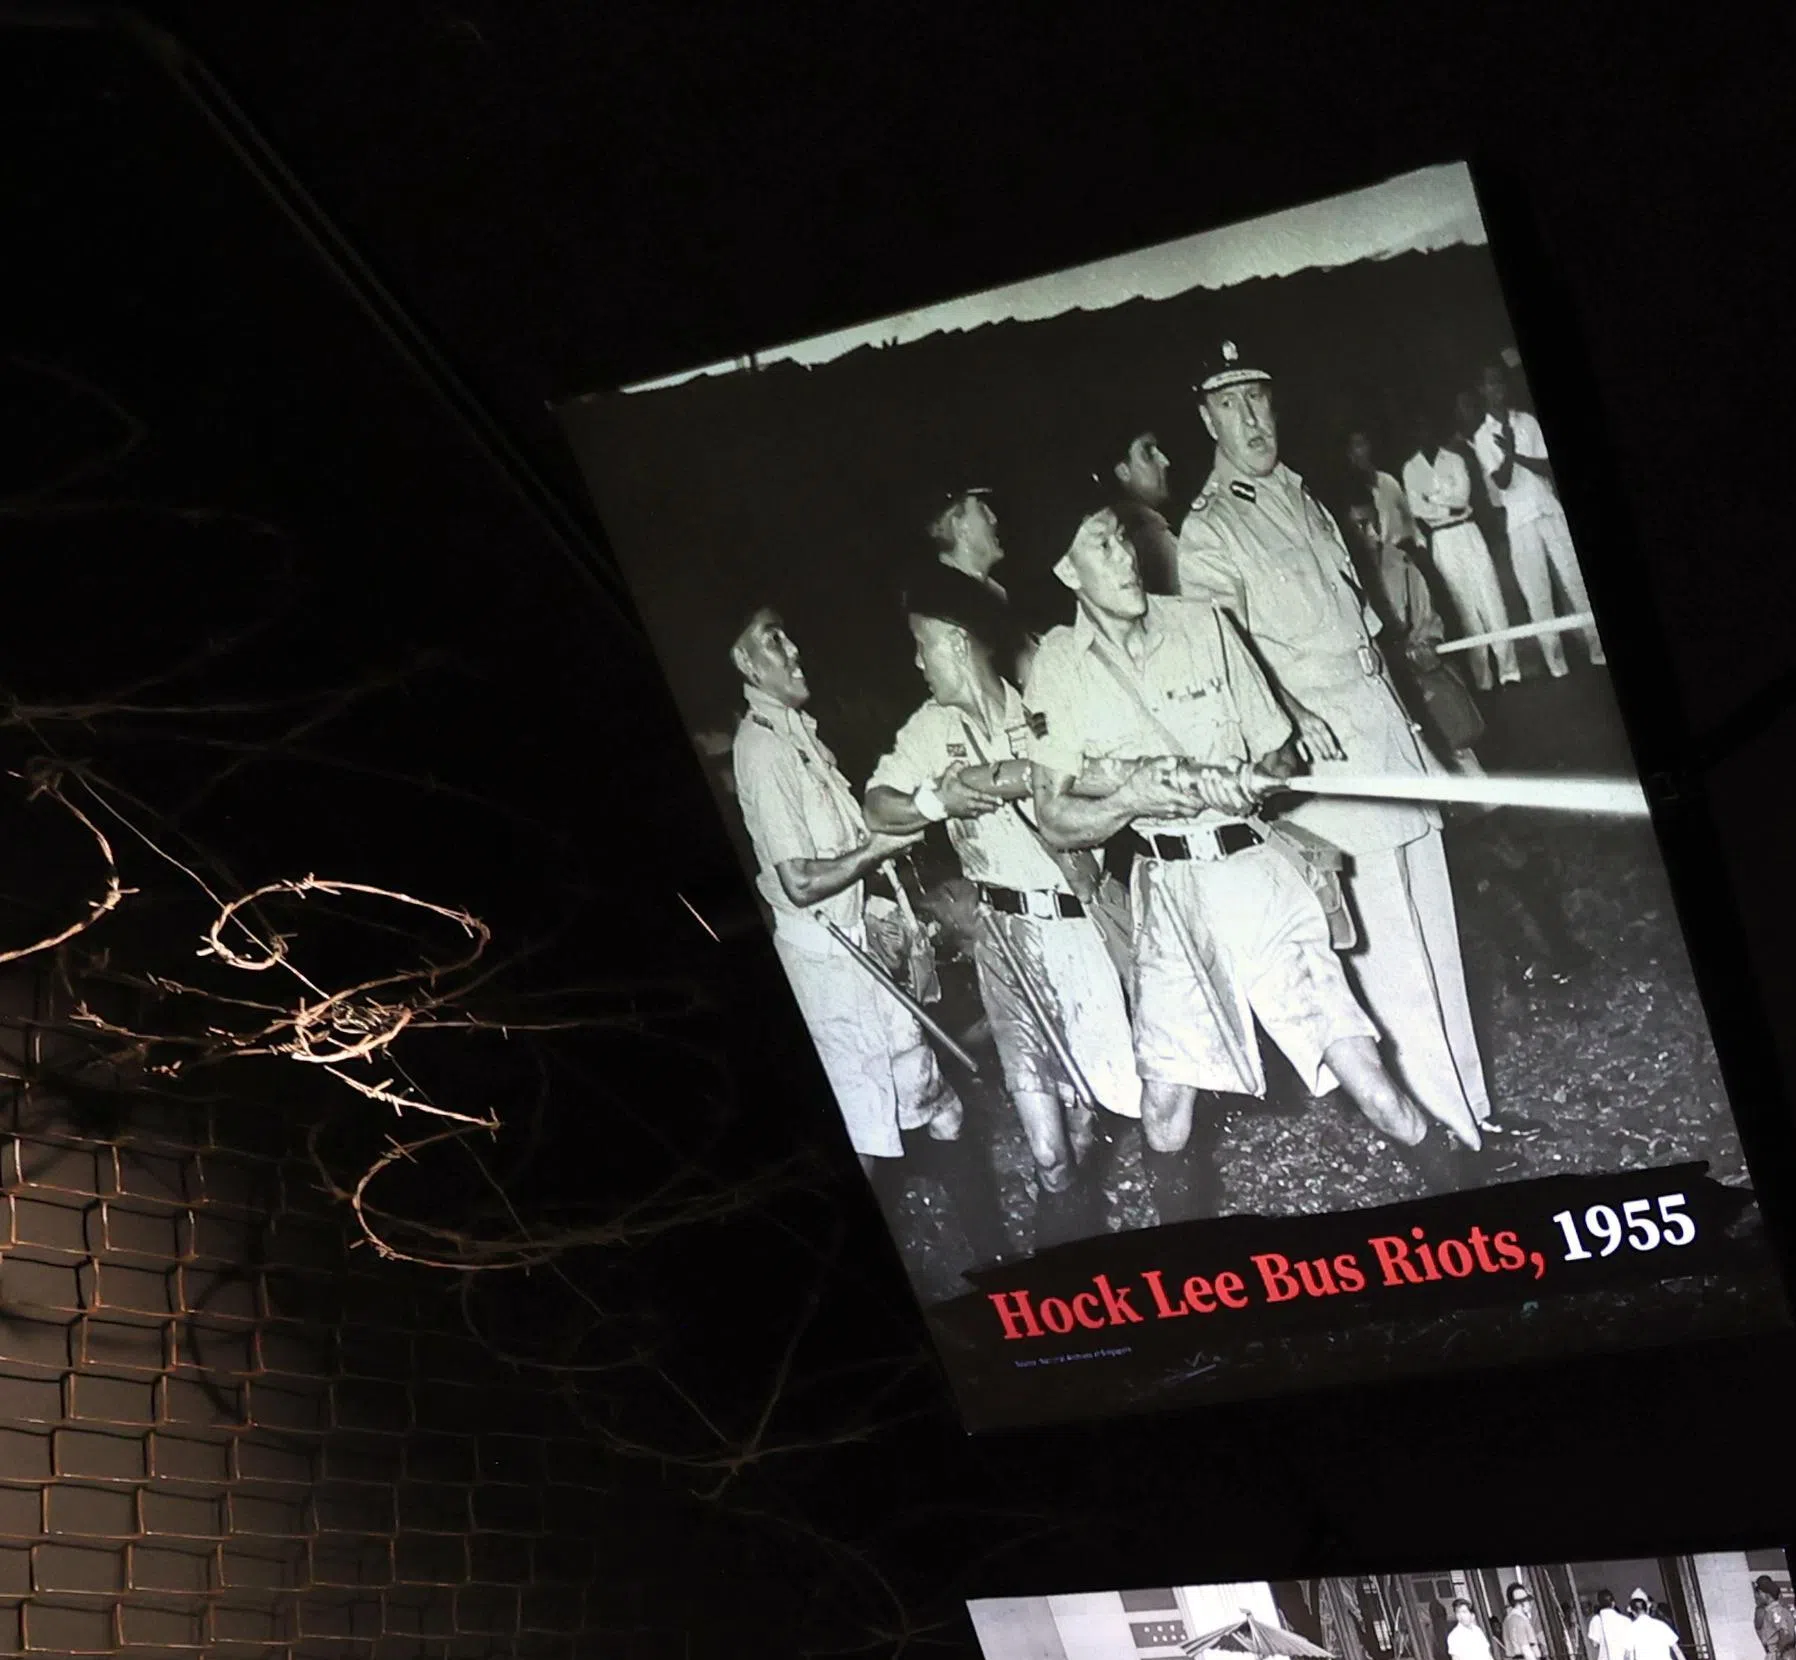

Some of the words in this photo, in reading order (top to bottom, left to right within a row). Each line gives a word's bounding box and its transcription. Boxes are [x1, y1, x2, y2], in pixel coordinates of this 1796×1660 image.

[988, 1274, 1142, 1340] Hock
[1141, 1266, 1248, 1321] Lee
[1250, 1248, 1365, 1304] Bus
[1368, 1226, 1546, 1288] Riots,
[1551, 1193, 1696, 1262] 1955
